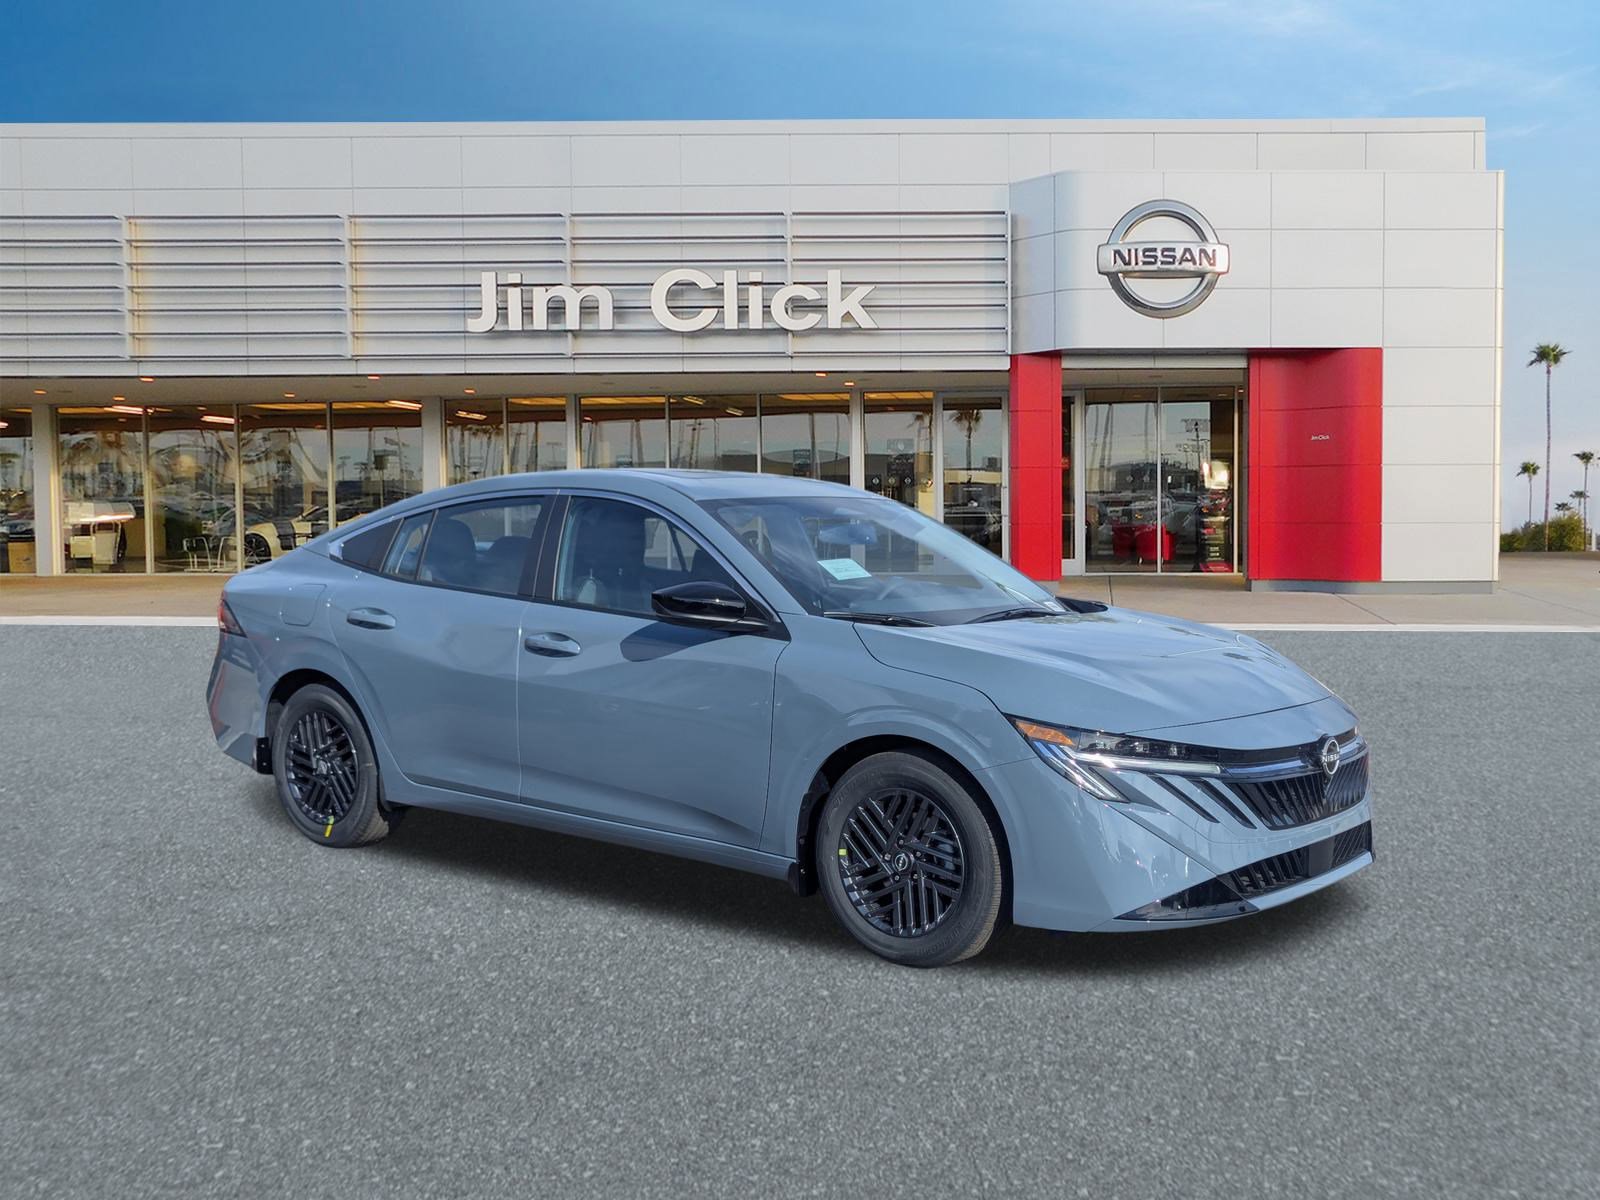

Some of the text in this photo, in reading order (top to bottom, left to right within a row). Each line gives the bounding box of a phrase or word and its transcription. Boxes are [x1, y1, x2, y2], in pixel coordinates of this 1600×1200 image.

[1112, 247, 1217, 267] NISSAN
[467, 268, 879, 333] Jim Click
